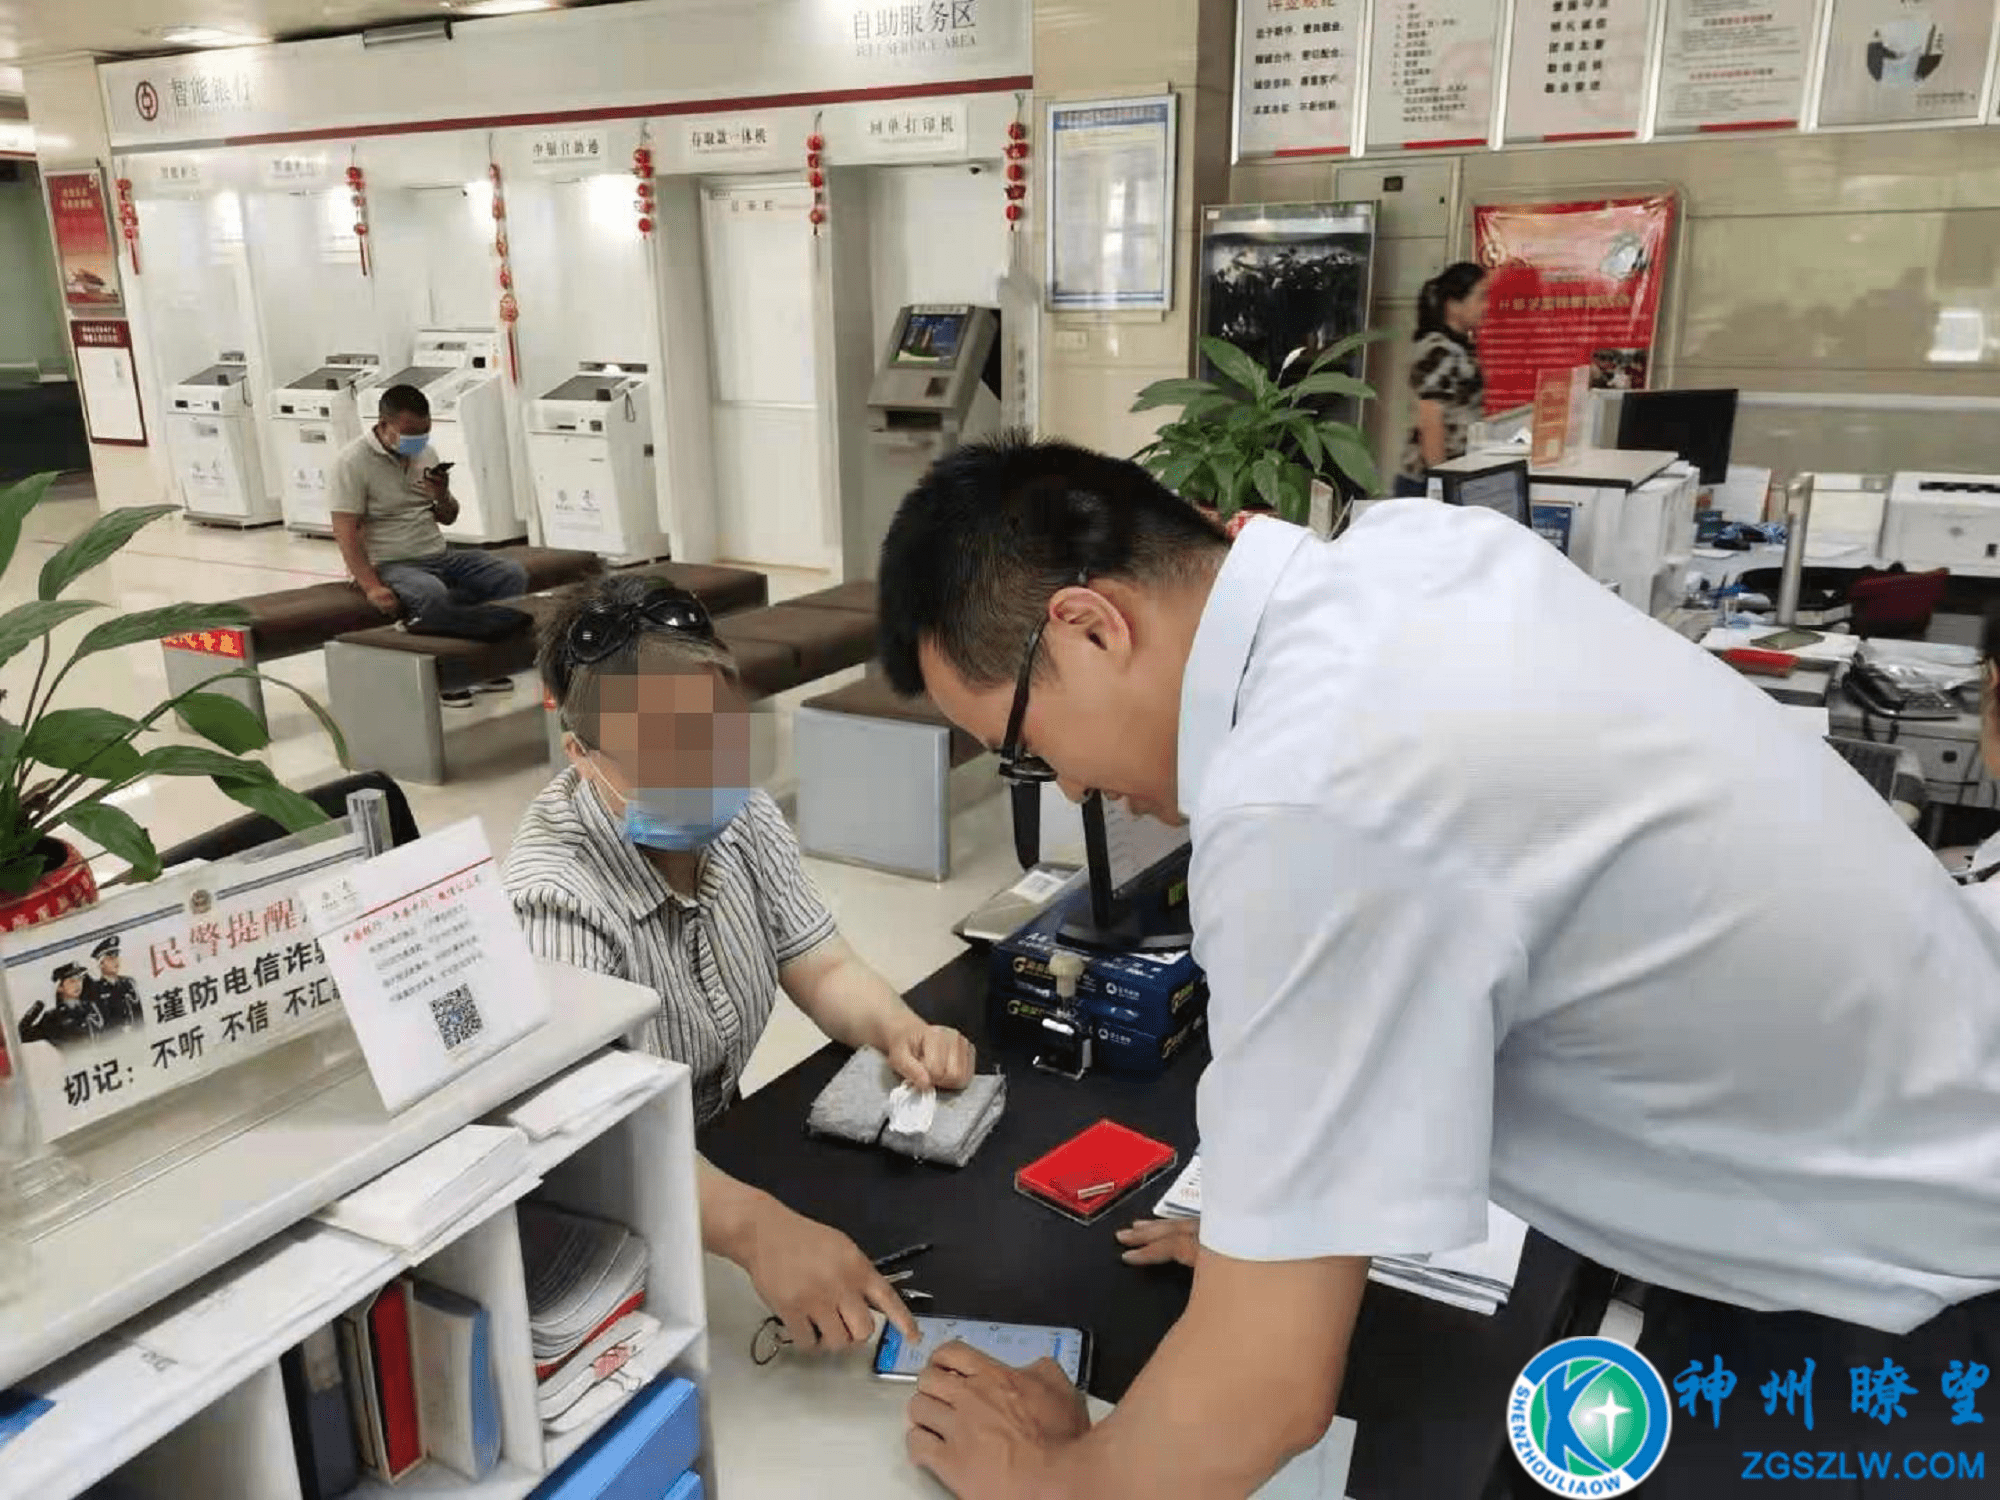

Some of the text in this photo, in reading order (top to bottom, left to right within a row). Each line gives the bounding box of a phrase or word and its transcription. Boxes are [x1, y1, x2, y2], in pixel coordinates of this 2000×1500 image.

[854, 0, 977, 40] 自助服务区
[169, 76, 251, 107] 智能银行
[149, 898, 298, 978] 民警提醒
[64, 1057, 134, 1108] 切记：
[150, 1025, 205, 1070] 不听
[220, 1000, 270, 1042] 不信
